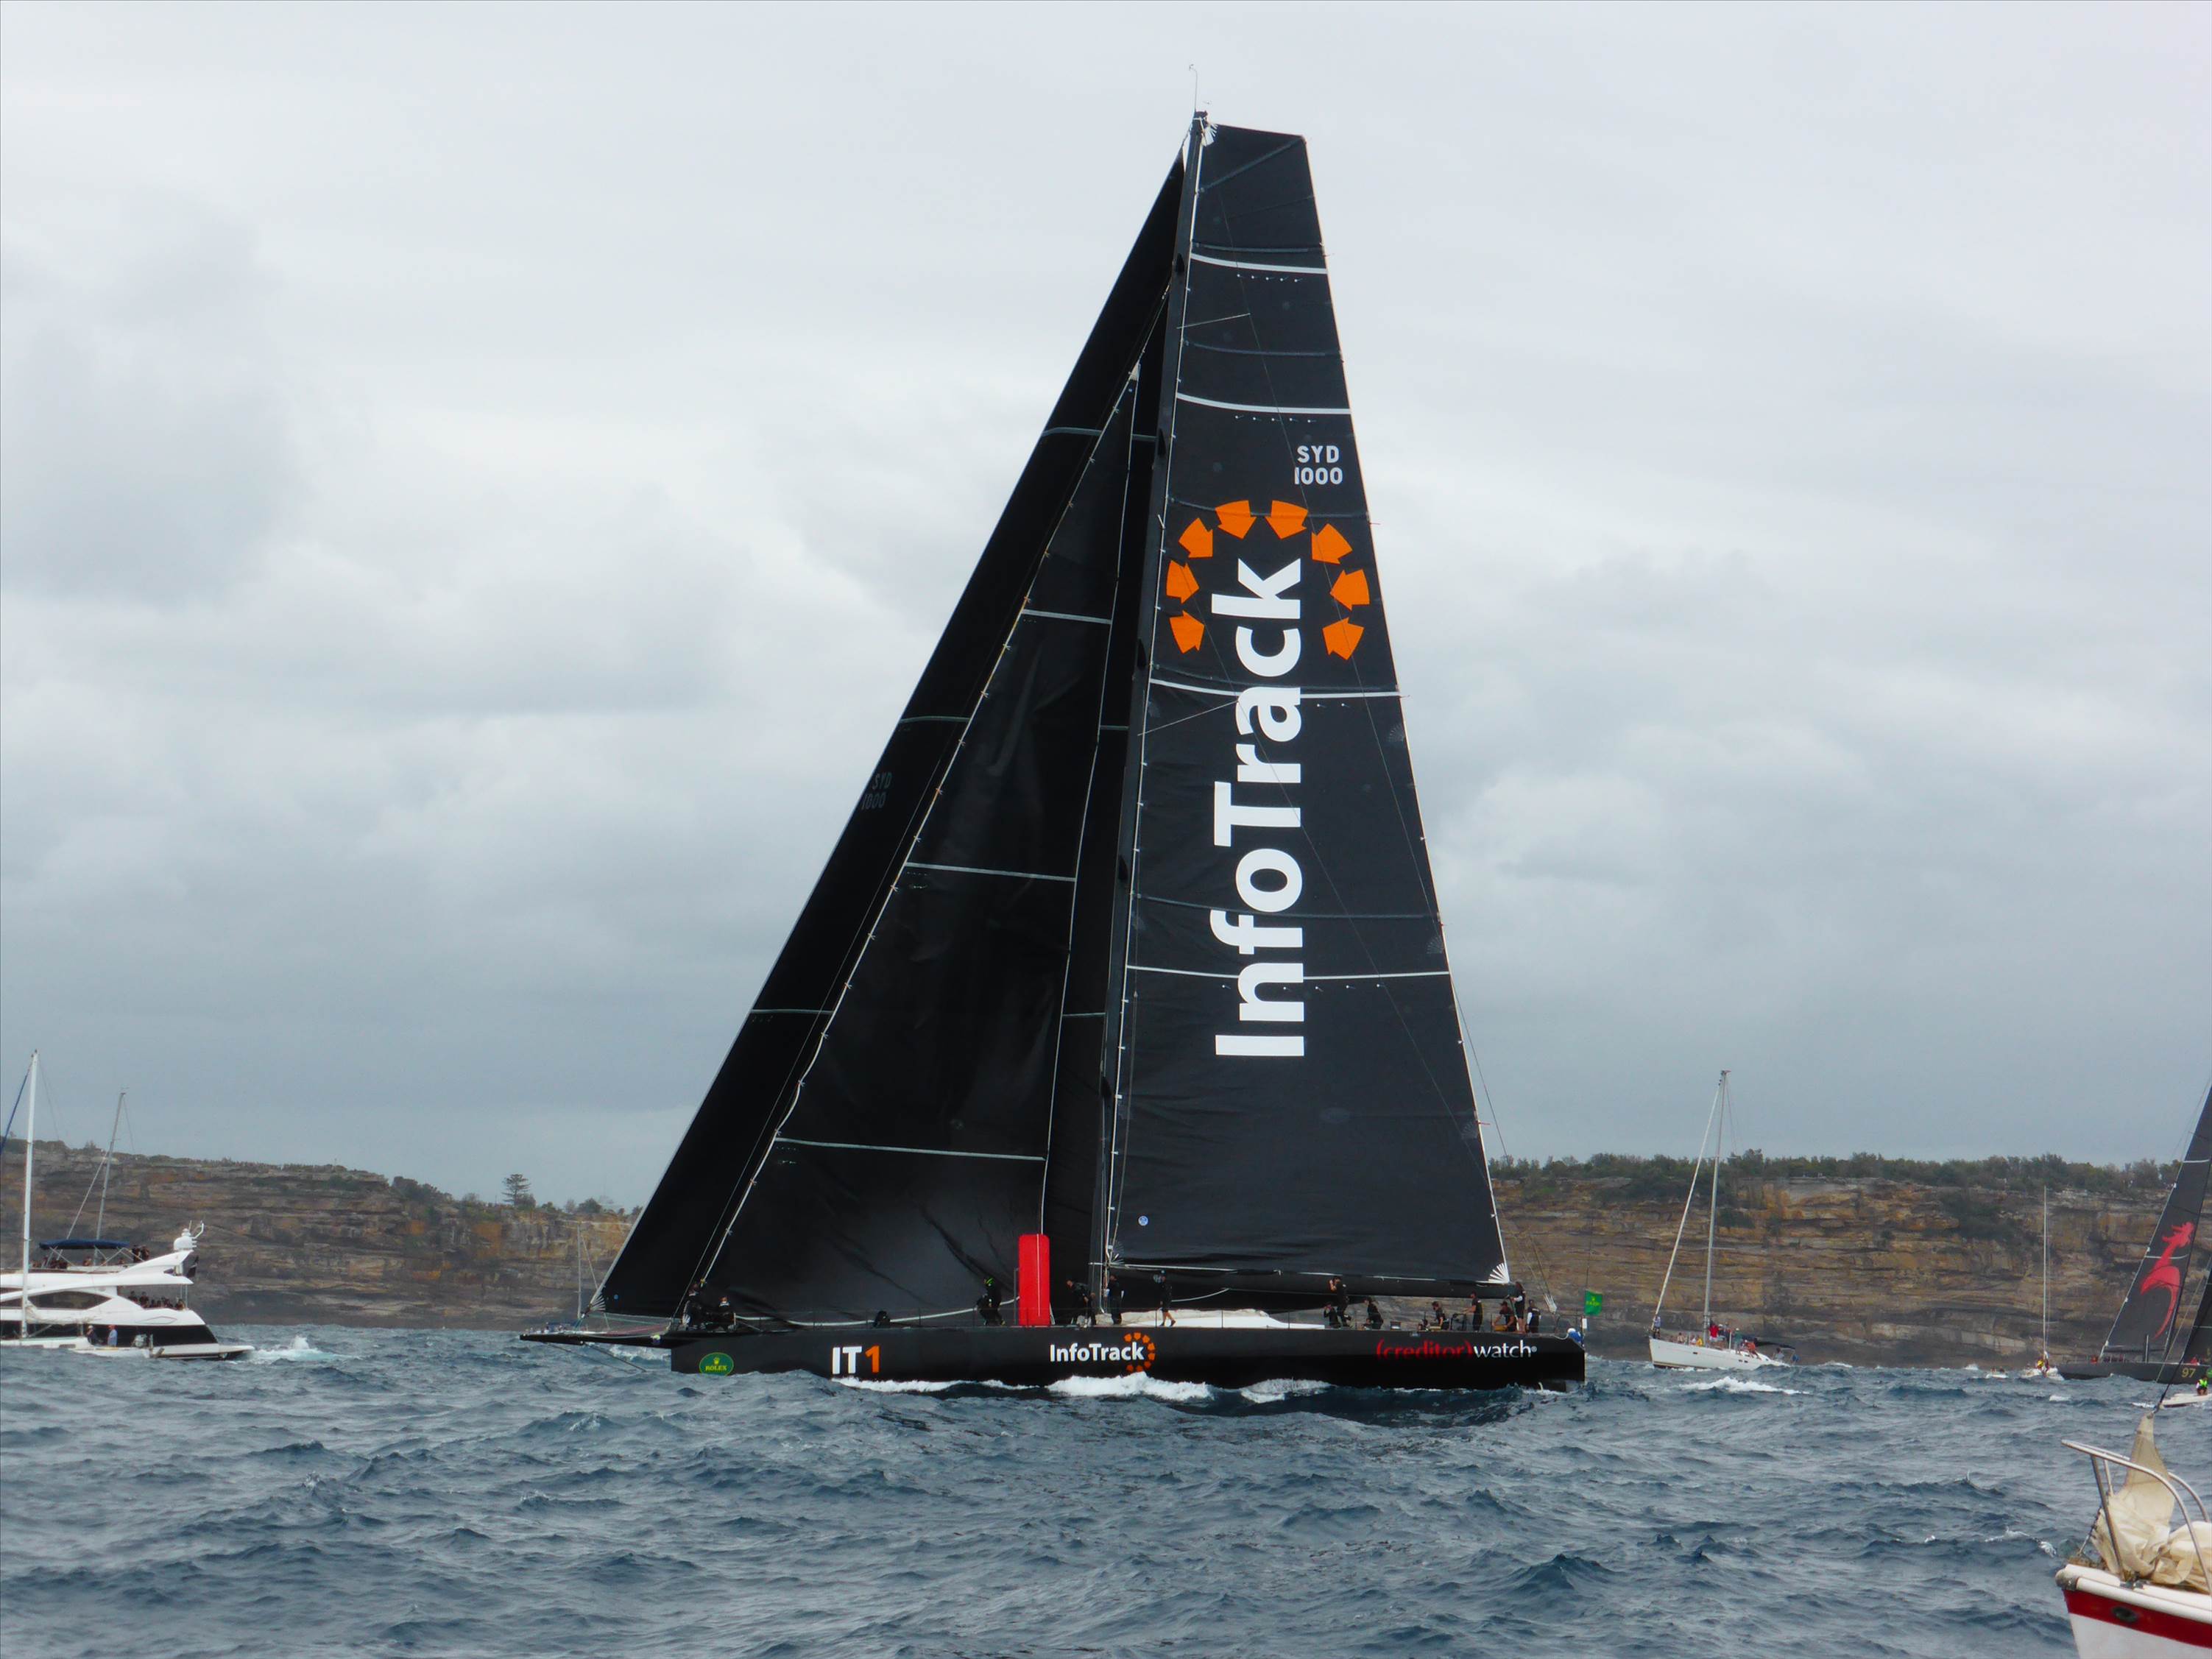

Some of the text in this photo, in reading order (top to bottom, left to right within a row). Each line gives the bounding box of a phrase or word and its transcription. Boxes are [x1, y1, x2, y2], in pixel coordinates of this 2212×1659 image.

[1297, 445, 1340, 463] SYD
[1294, 467, 1343, 485] 1000
[1210, 557, 1305, 1057] InfoTrack
[1050, 1341, 1145, 1362] InfoTrack
[2181, 1367, 2196, 1378] 97
